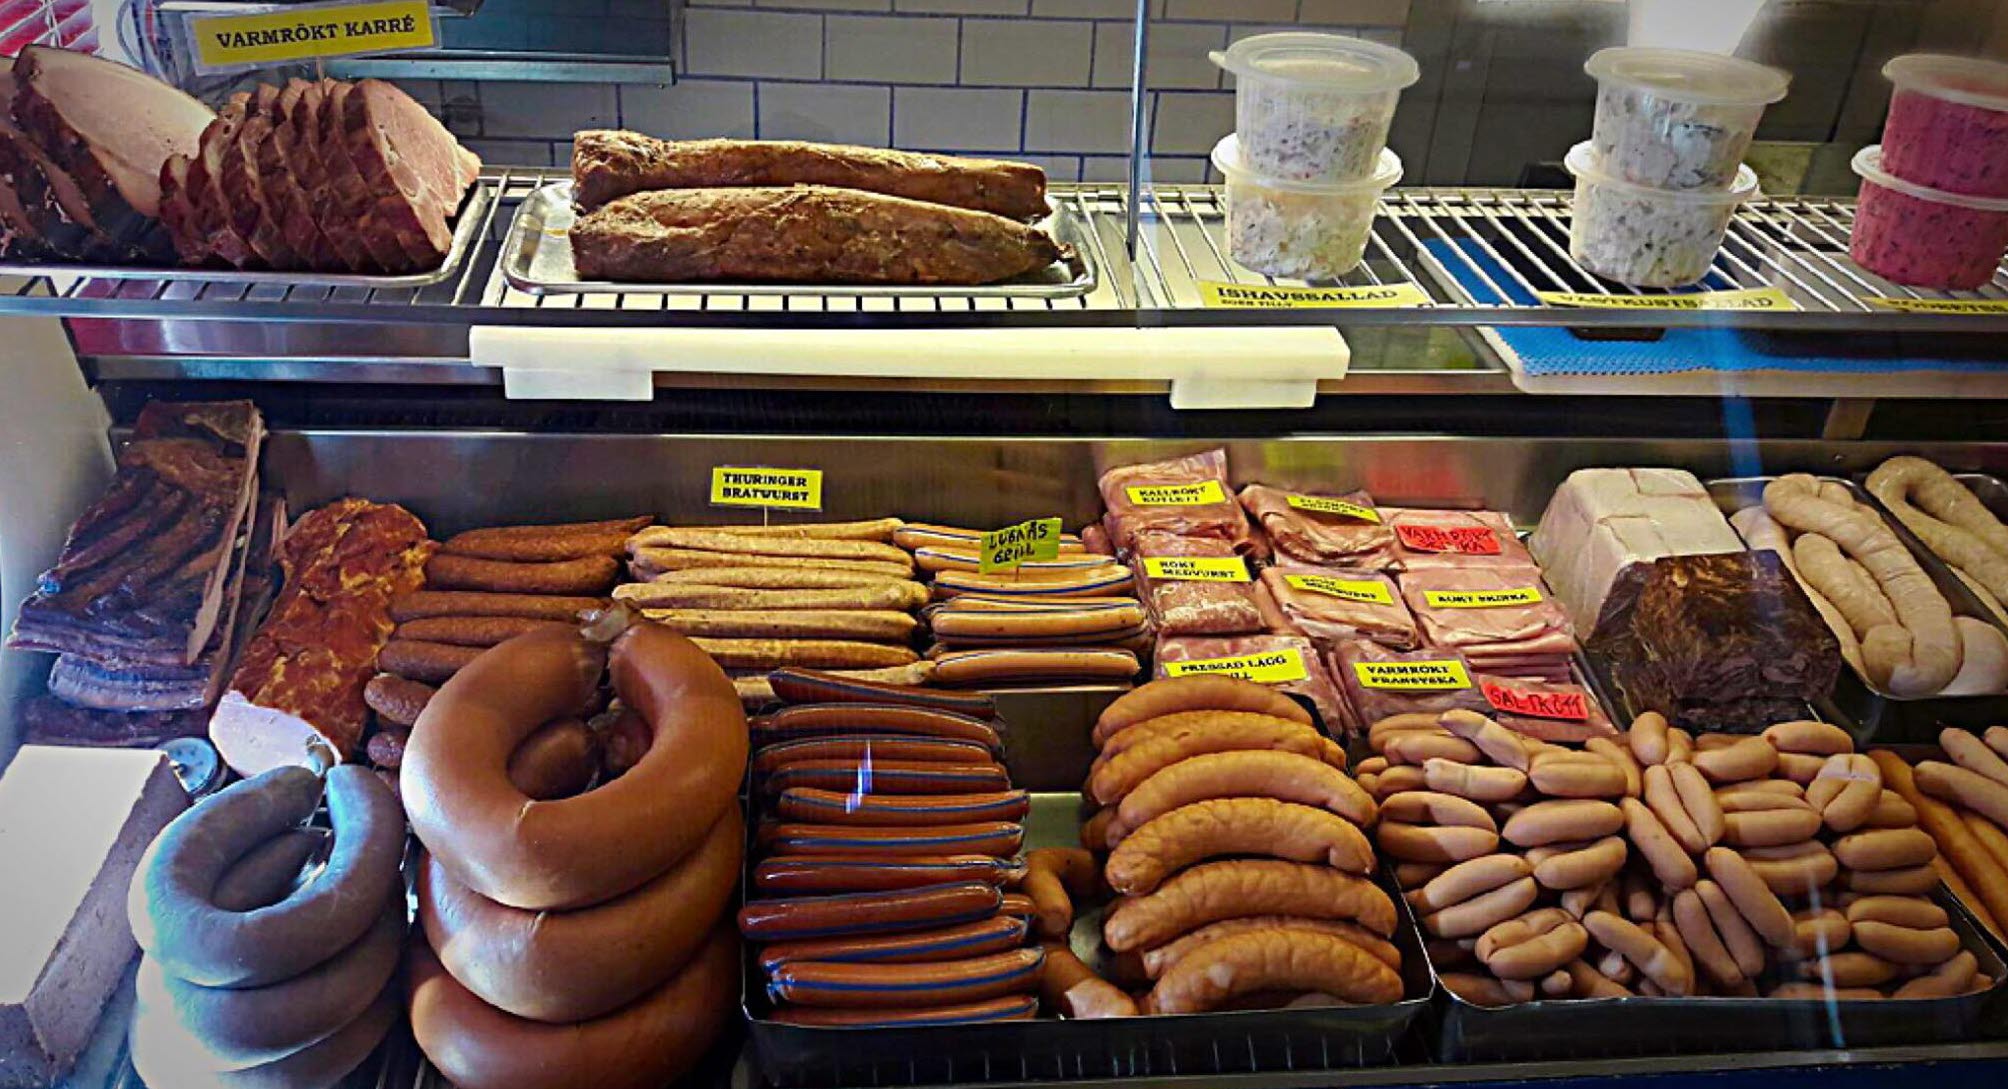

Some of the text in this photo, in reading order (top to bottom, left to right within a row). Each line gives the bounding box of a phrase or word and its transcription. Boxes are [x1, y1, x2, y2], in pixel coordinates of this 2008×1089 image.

[216, 14, 416, 49] VARMRÖKT KARRÉ
[1217, 286, 1398, 302] ISHAVSSALLAD
[723, 472, 808, 487] THURINGER
[722, 487, 809, 501] BRATWURST
[1180, 663, 1245, 673] PRESSAD
[1366, 665, 1450, 674] VARMRÖKT
